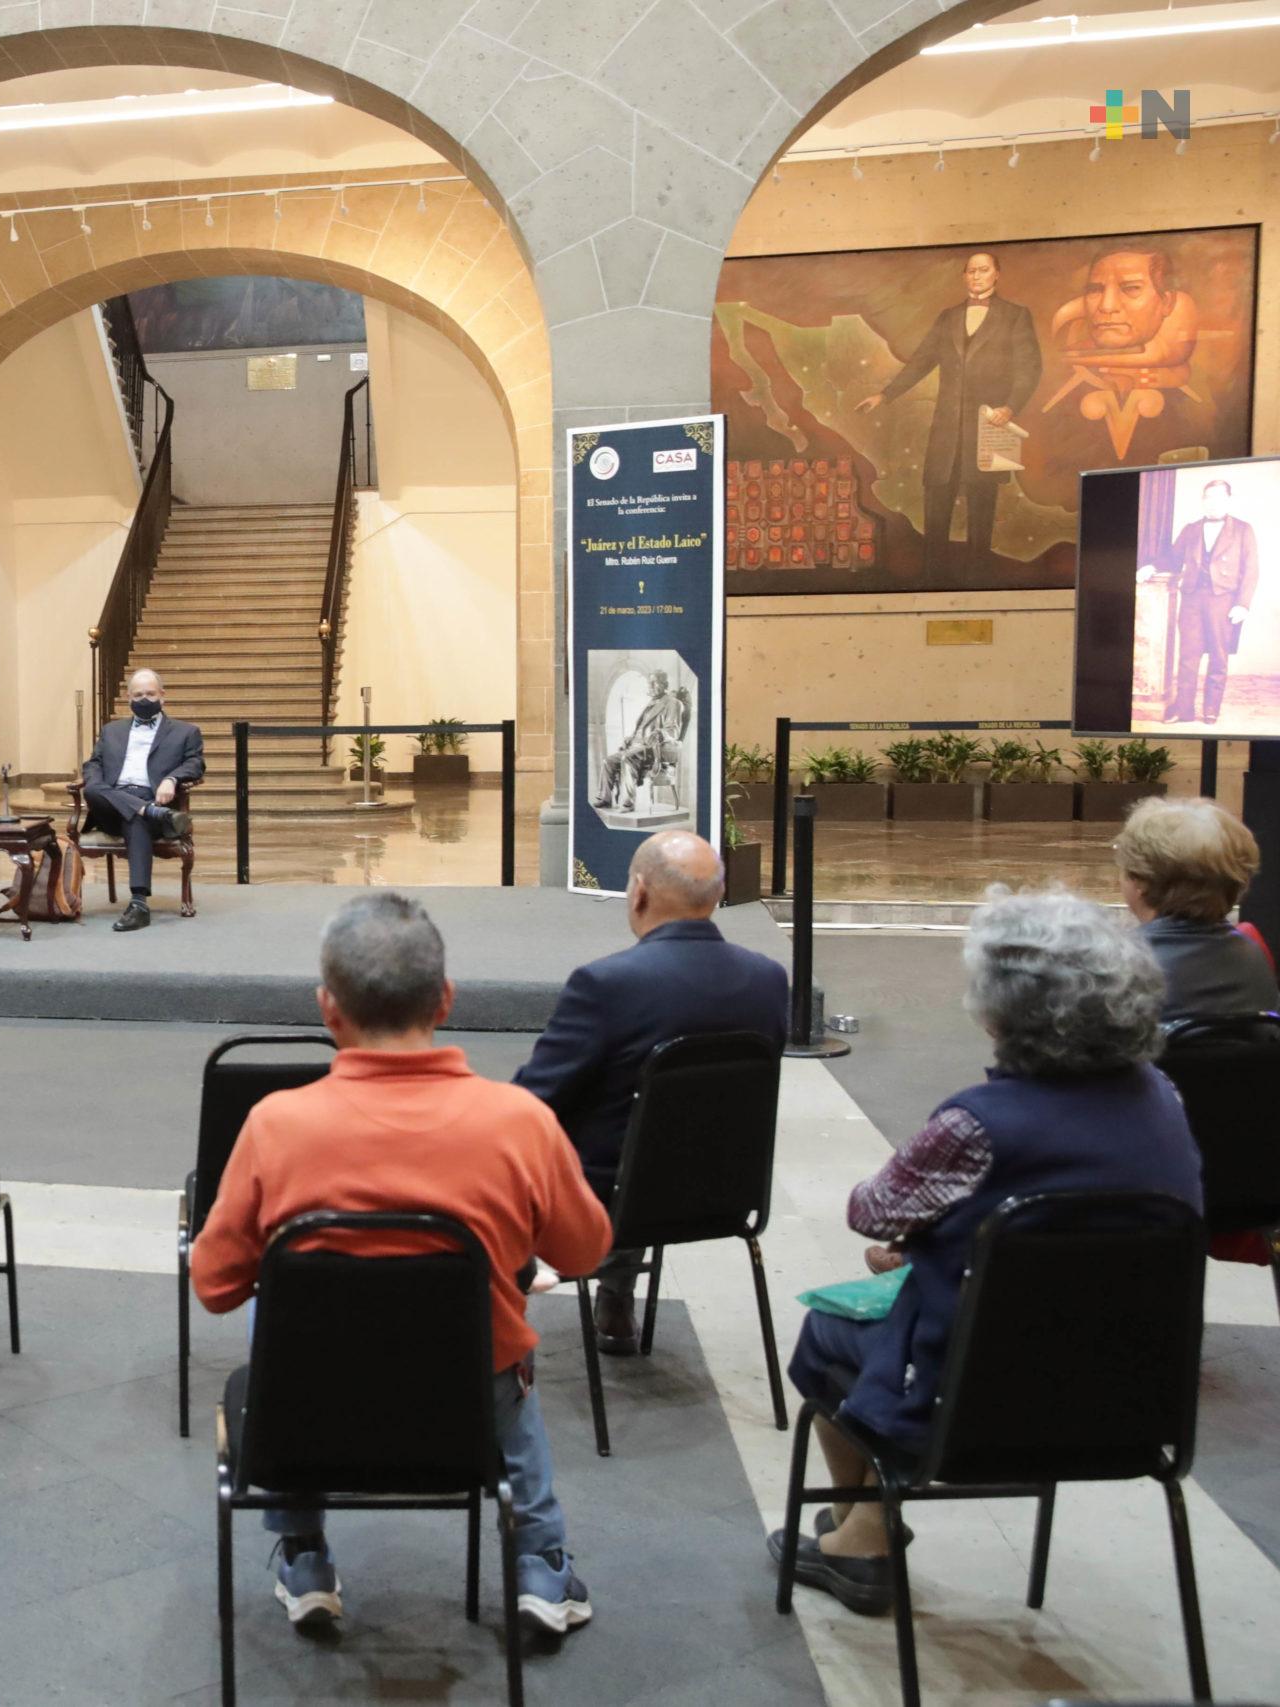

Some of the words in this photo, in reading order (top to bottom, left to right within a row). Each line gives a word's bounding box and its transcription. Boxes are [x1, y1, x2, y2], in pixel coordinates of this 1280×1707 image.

[655, 452, 693, 464] CASA
[595, 497, 619, 506] Senado
[621, 496, 628, 504] de
[629, 496, 636, 504] la
[637, 494, 670, 506] República
[671, 493, 691, 502] invita
[618, 507, 624, 515] la
[625, 505, 666, 514] conferencia:
[618, 540, 625, 554] y
[626, 536, 636, 550] el
[638, 534, 672, 549] Estado
[605, 557, 620, 566] Mtro.
[621, 556, 641, 566] Rubén
[641, 555, 656, 565] Ruiz
[656, 555, 678, 564] Guerra
[600, 606, 608, 615] 21
[608, 606, 616, 615] de
[616, 607, 636, 616] marzo,
